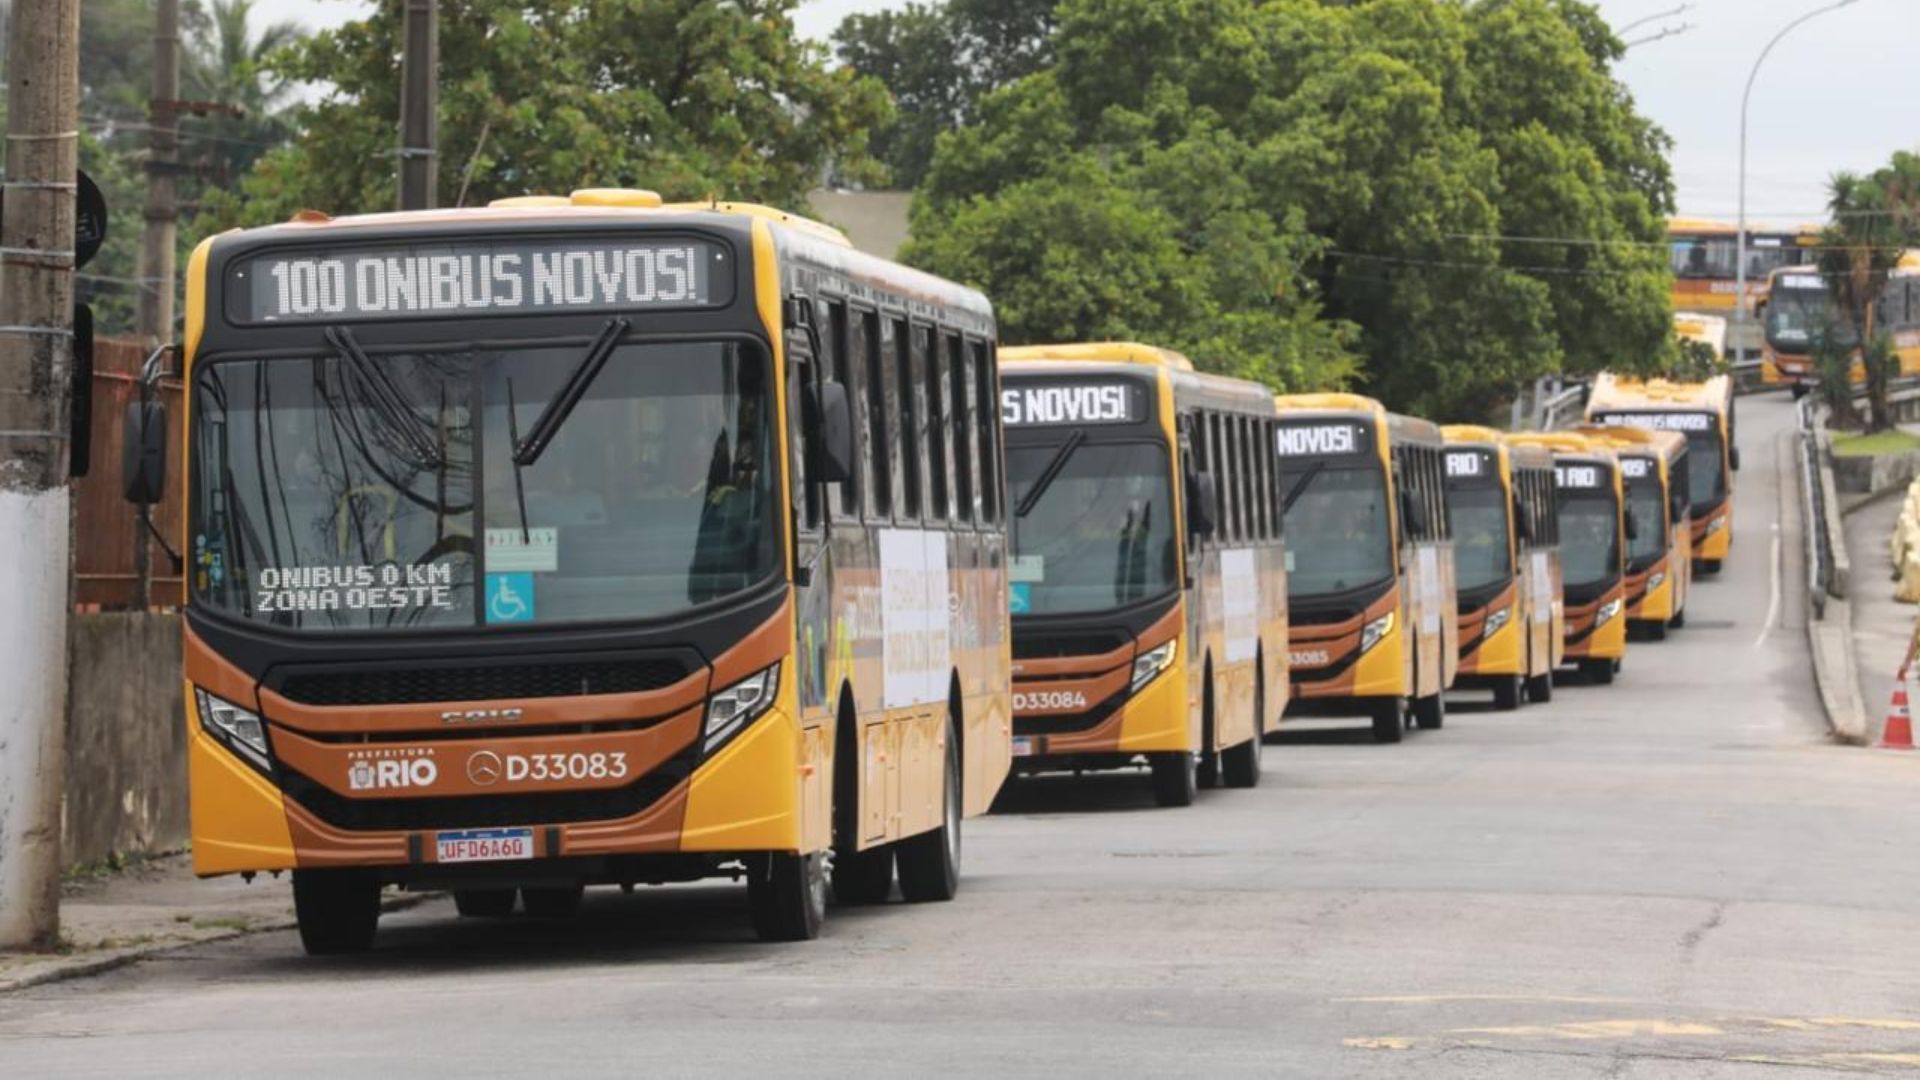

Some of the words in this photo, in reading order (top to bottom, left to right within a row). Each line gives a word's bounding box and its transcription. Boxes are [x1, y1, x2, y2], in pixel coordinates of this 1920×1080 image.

[271, 260, 346, 314] 100
[356, 254, 523, 311] ONIBUS
[532, 247, 696, 305] NOVOS!
[1025, 386, 1126, 422] NOVOS!
[1277, 425, 1352, 455] NOVOS!
[1446, 454, 1478, 476] RIO
[260, 565, 375, 588] ONIBUS
[382, 564, 399, 584] 0
[406, 563, 451, 585] KM
[258, 588, 340, 612] ZONA
[346, 586, 452, 608] OESTE
[1012, 692, 1087, 710] D33084
[348, 748, 435, 759] PREFEITURA
[507, 753, 628, 780] D33083
[377, 759, 438, 787] RIO
